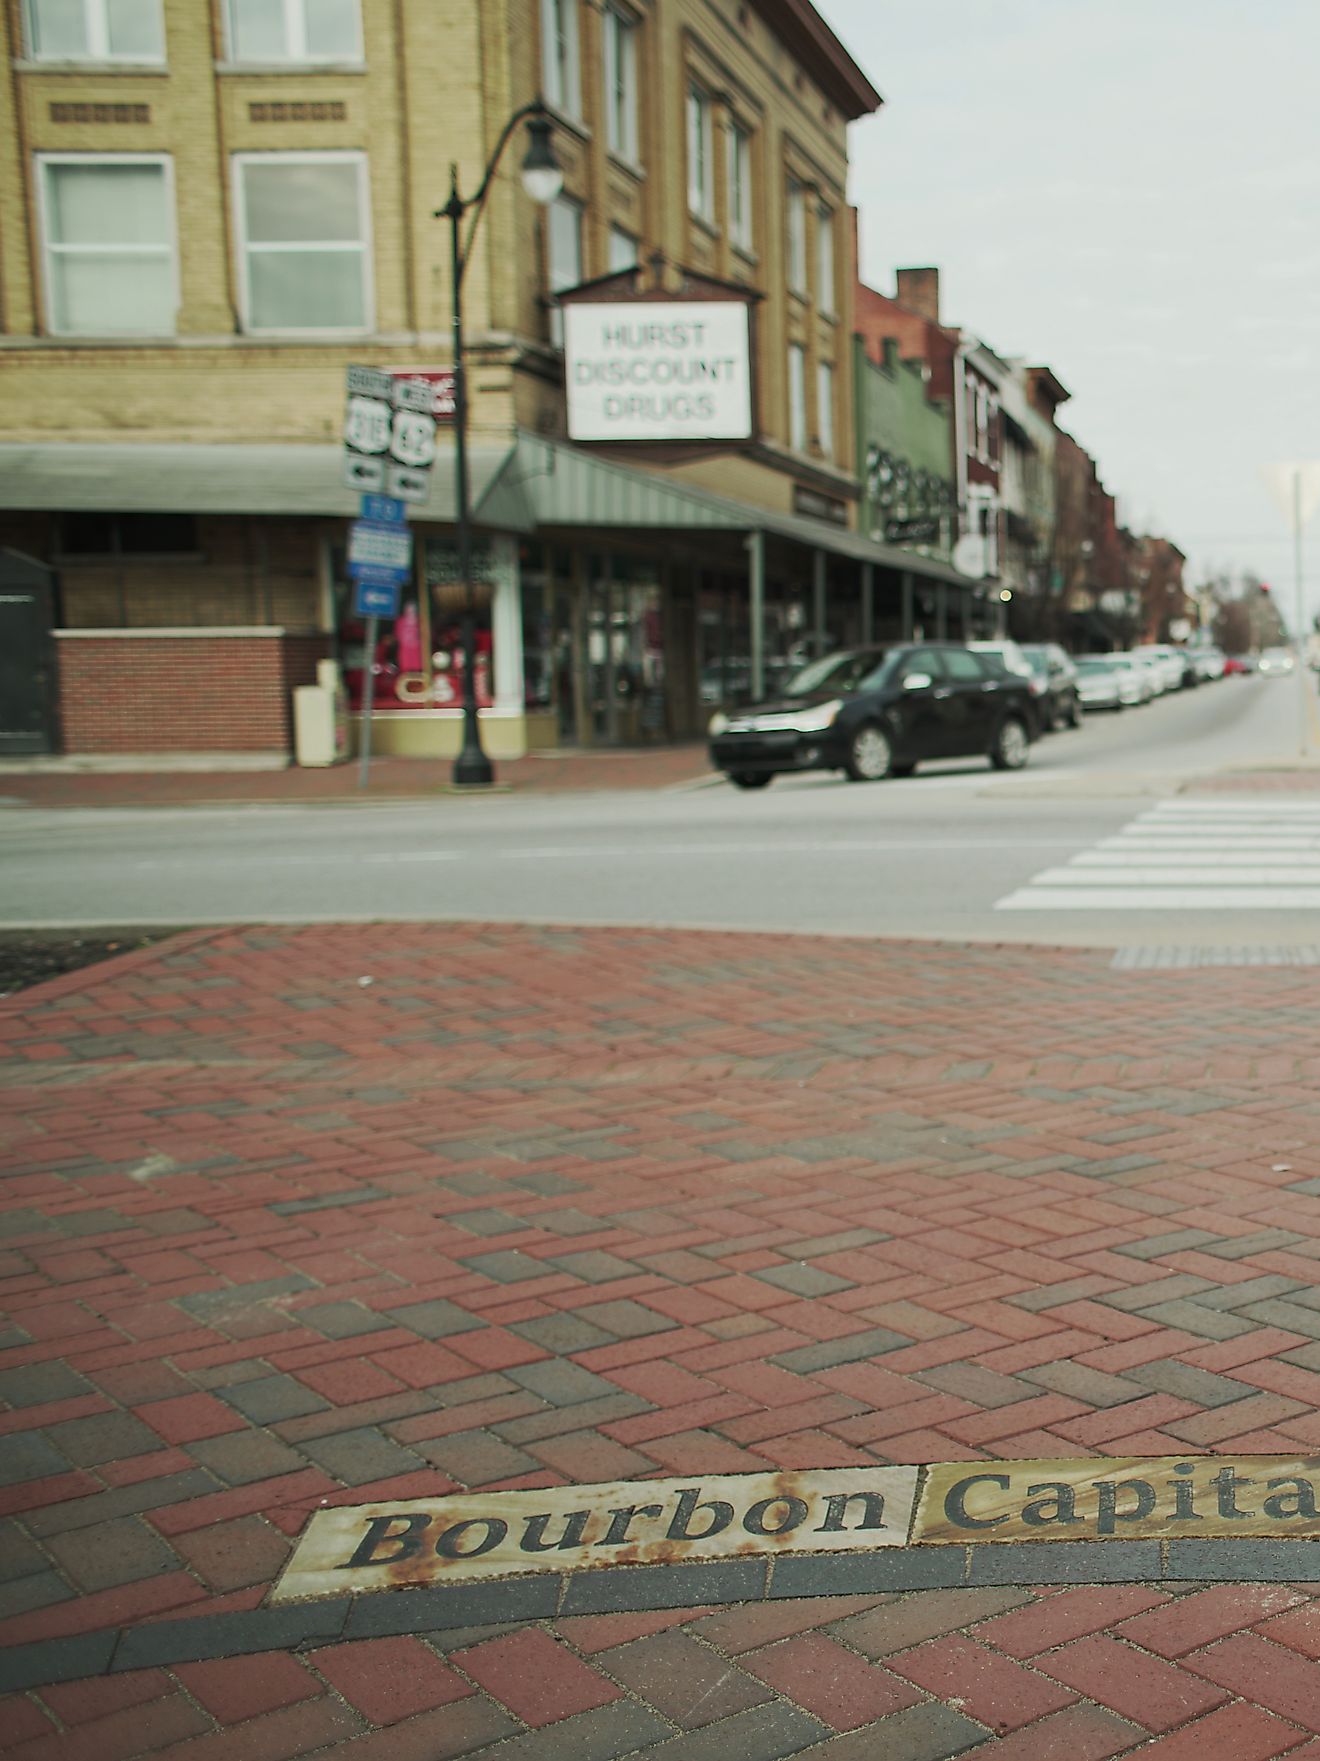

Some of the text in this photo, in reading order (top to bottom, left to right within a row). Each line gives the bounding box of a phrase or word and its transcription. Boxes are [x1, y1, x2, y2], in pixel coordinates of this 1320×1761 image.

[602, 321, 705, 349] HURST
[575, 357, 736, 386] DISCOUNT
[603, 393, 717, 421] DRUGS
[335, 1487, 888, 1571] Bourbon
